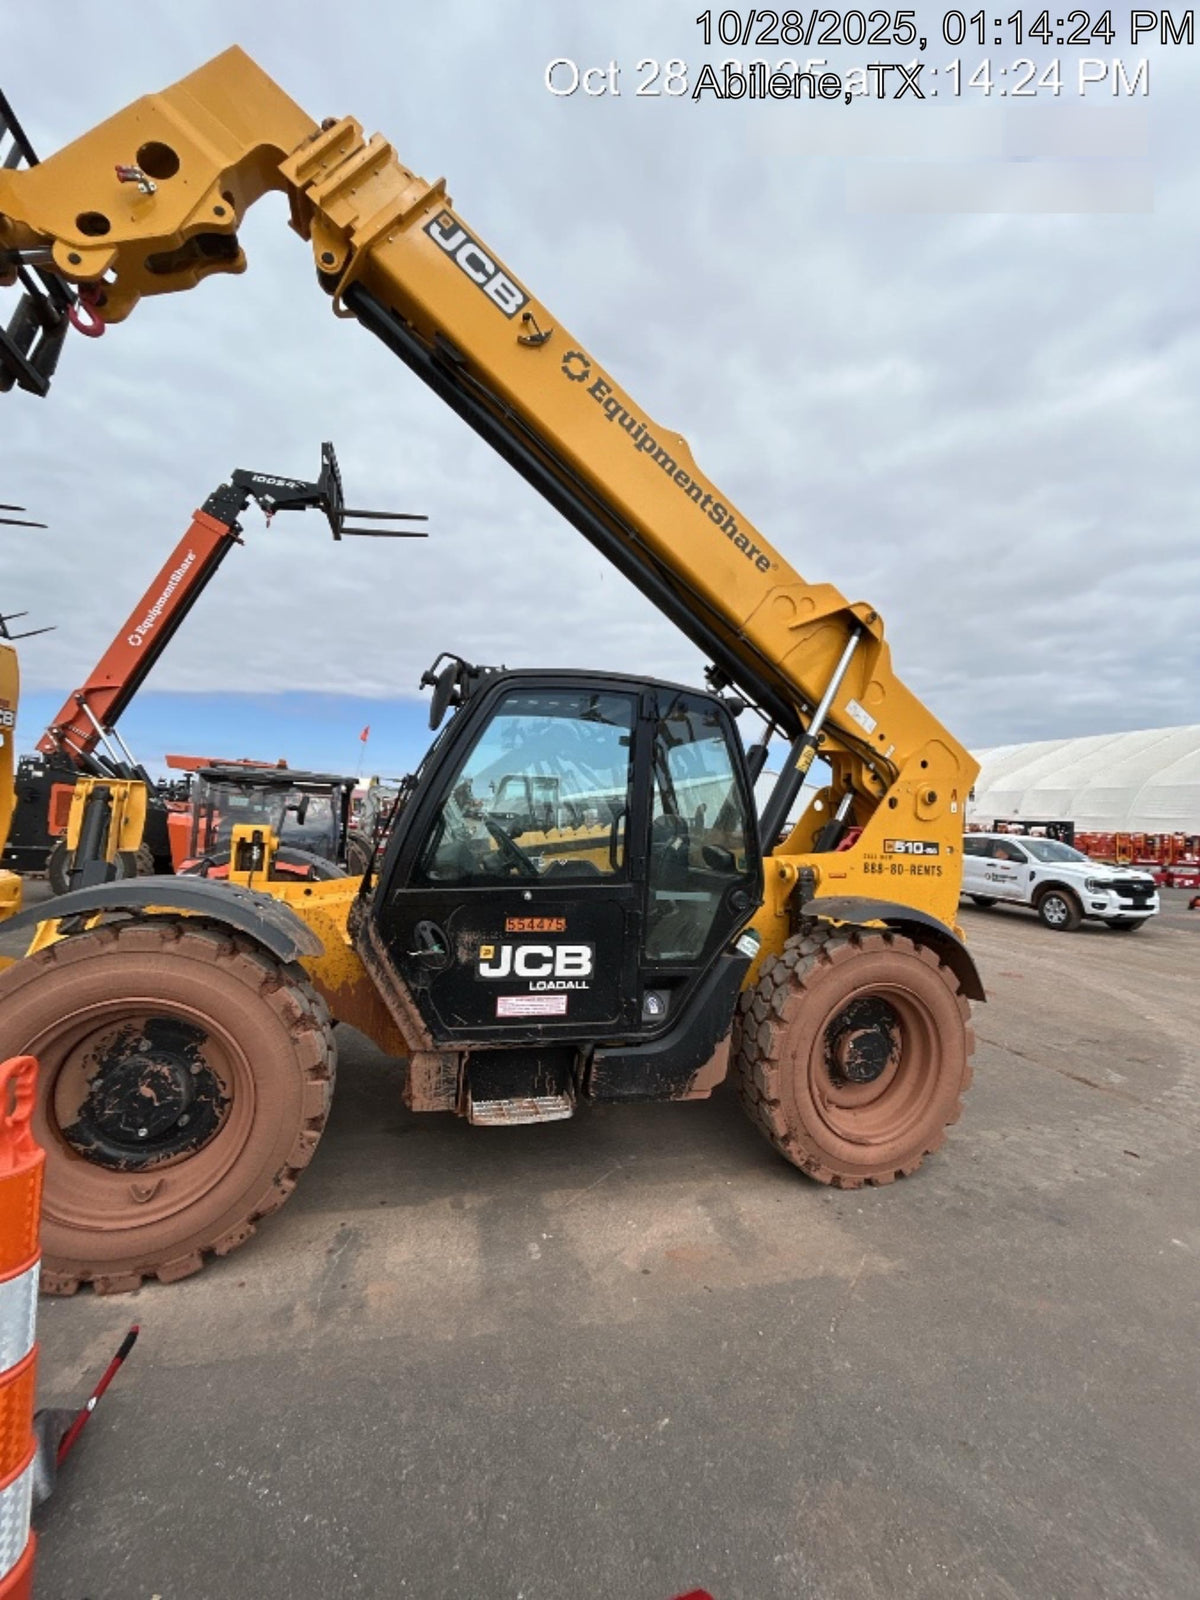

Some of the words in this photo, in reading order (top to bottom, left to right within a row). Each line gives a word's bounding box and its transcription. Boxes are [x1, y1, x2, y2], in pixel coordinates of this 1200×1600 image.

[428, 215, 525, 315] JCB
[586, 375, 771, 574] EquipmentShare
[134, 549, 197, 636] EquipmentShare
[507, 917, 566, 931] 554475
[479, 945, 593, 978] JCB
[528, 980, 590, 992] LOADALL
